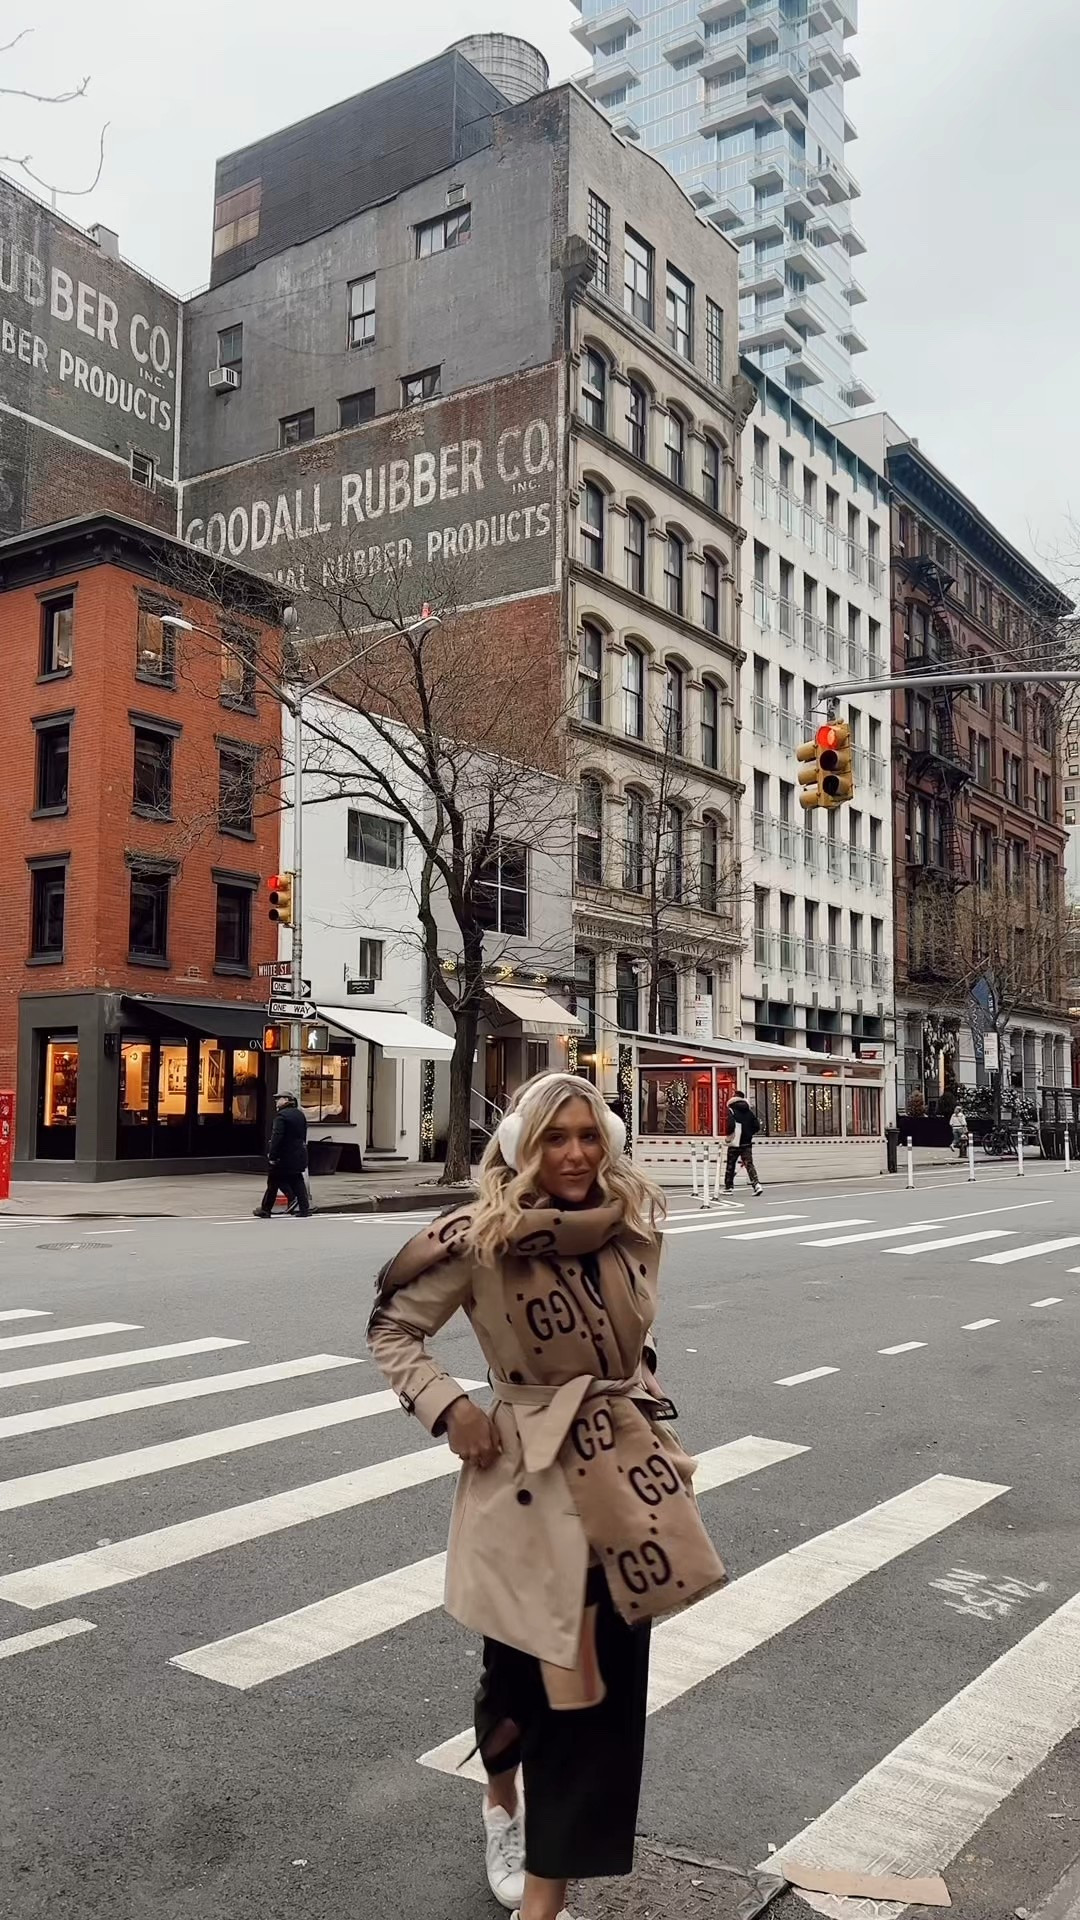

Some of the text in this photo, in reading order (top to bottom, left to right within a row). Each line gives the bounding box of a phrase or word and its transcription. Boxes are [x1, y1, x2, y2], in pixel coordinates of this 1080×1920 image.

[129, 313, 175, 380] CO.
[59, 348, 172, 431] PRODUCTS
[139, 367, 166, 389] INC.
[184, 418, 555, 557] GOODALL RUBBER CO.
[512, 478, 541, 495] INC.
[427, 502, 551, 563] PRODUCTS
[258, 963, 288, 977] WHITE ST
[274, 982, 287, 991] ONE
[273, 1004, 311, 1014] ONE WAY
[526, 1290, 576, 1341] GG
[572, 1409, 616, 1461] GG
[628, 1454, 679, 1506] GG
[618, 1540, 671, 1594] GG
